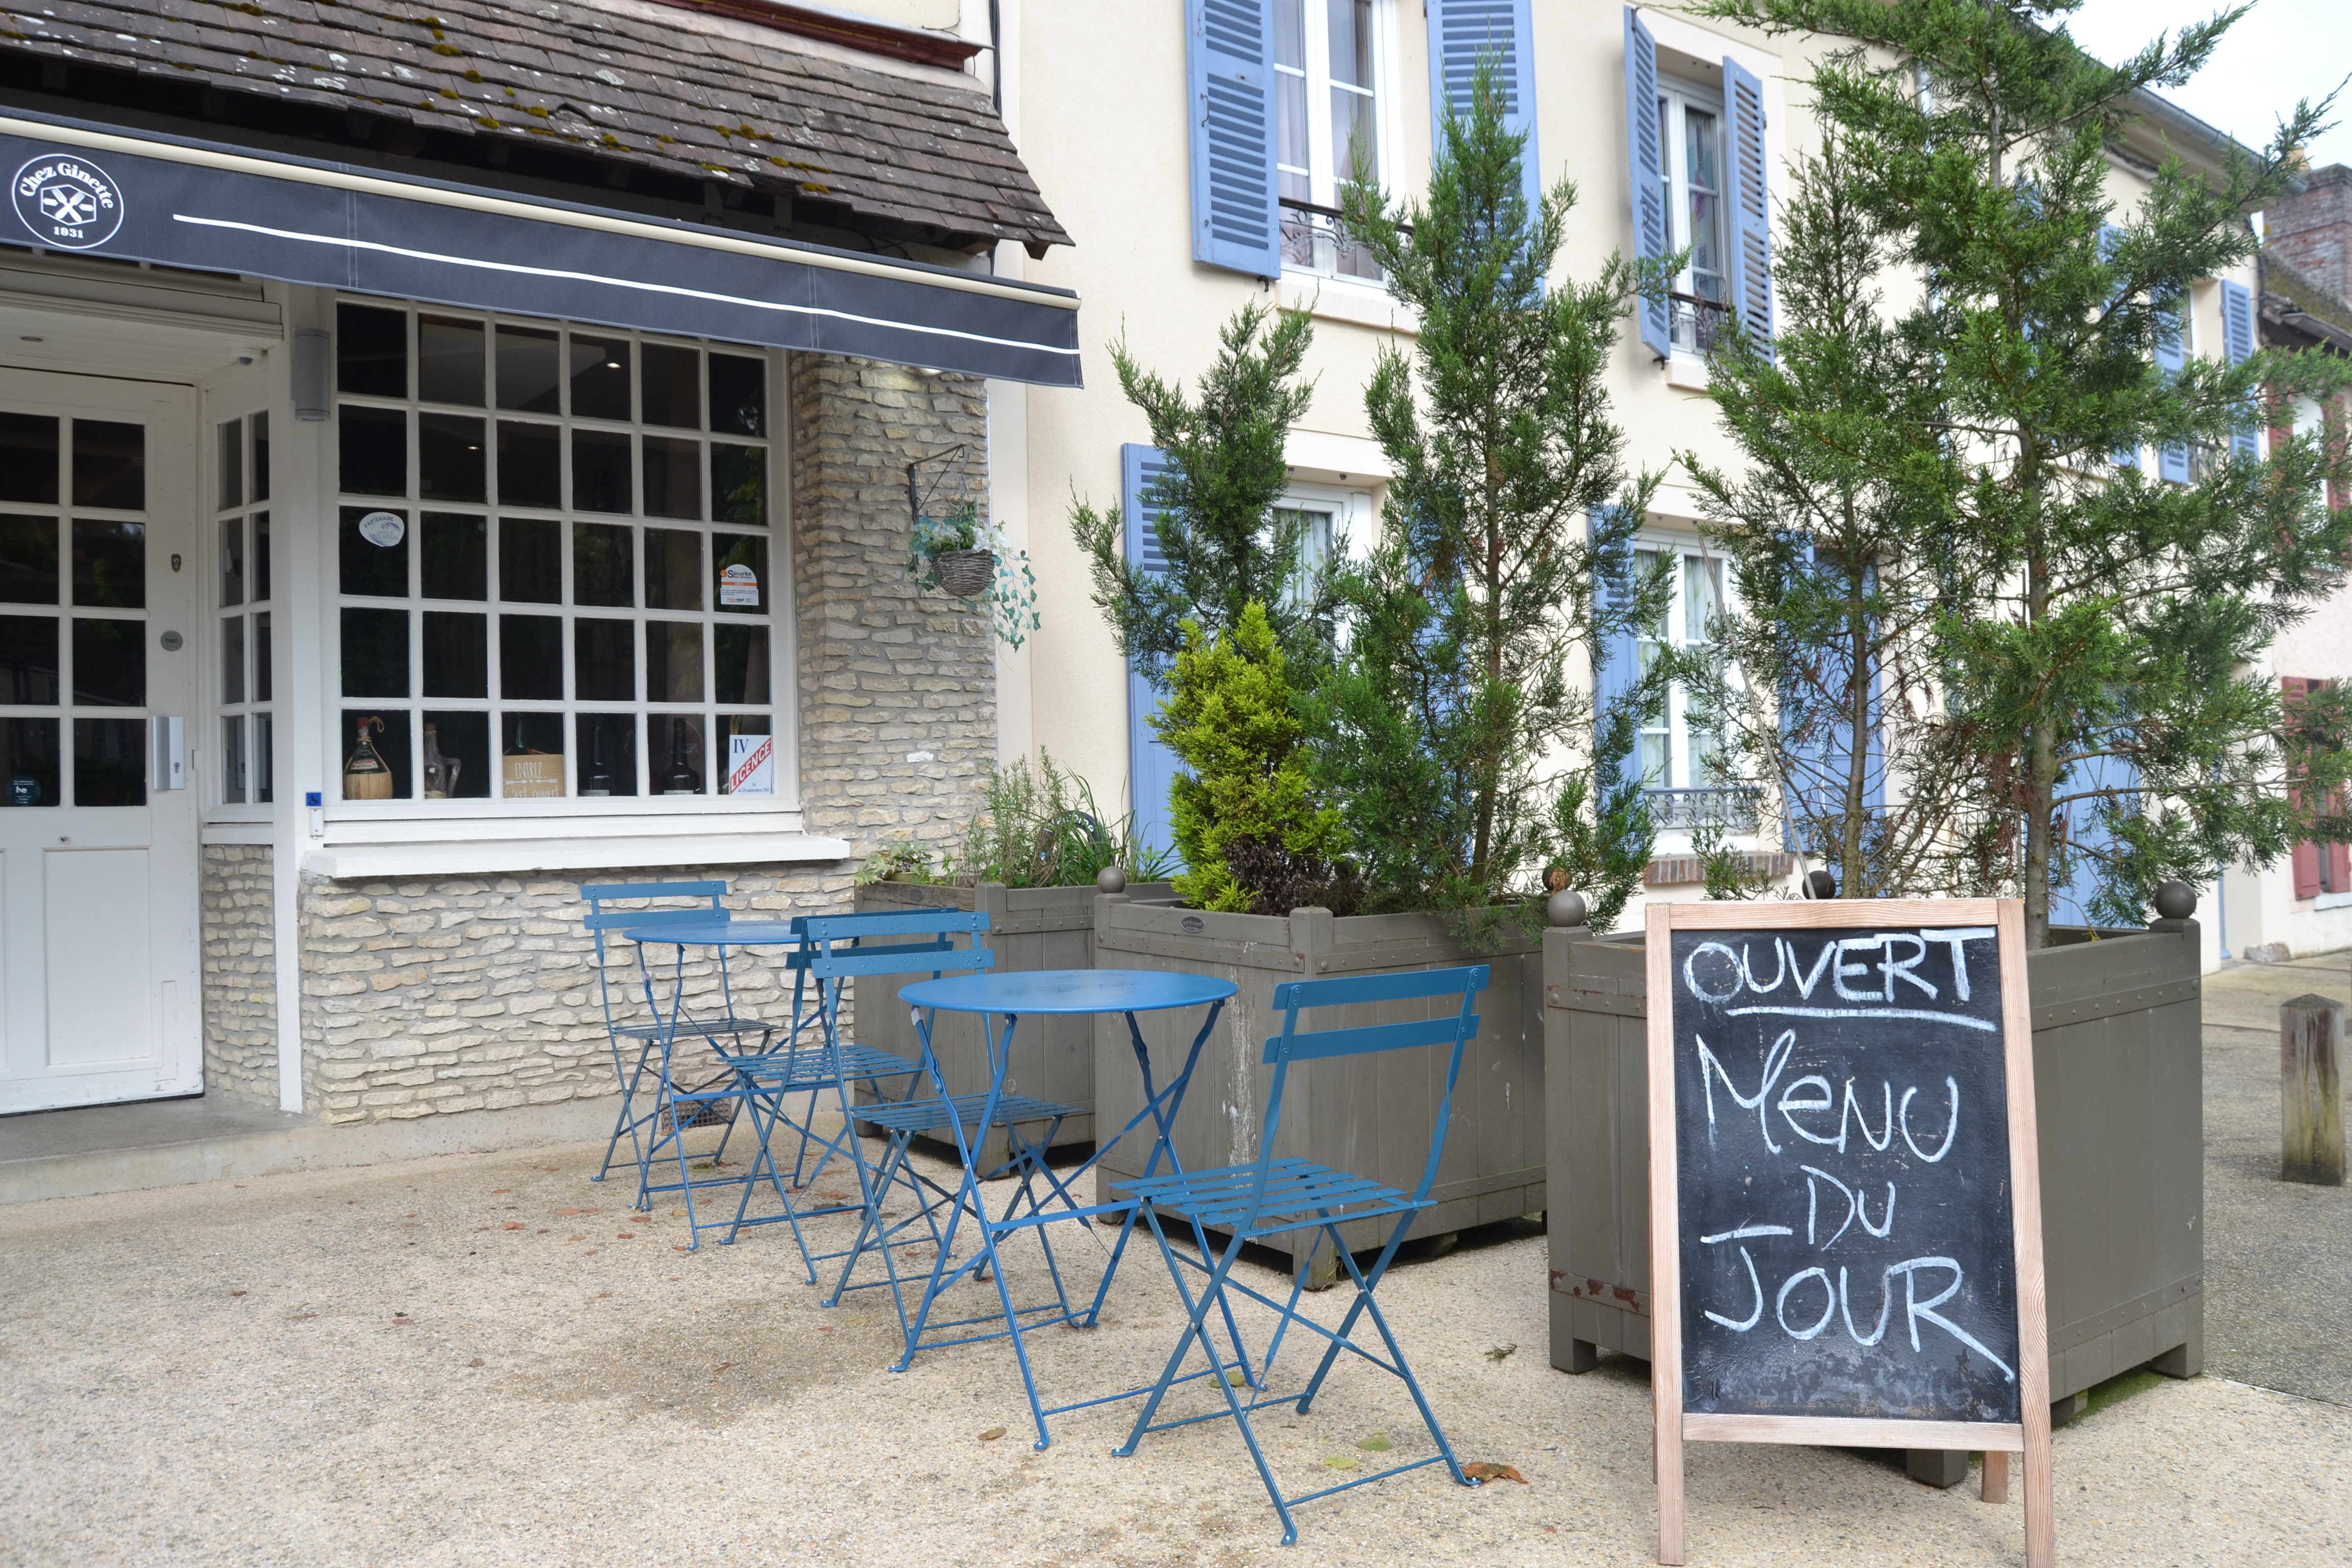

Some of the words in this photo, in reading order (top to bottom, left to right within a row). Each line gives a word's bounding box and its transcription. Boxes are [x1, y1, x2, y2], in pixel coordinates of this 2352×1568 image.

[20, 166, 57, 197] Chez
[57, 162, 114, 209] Ginette
[53, 226, 84, 239] 1931
[363, 516, 394, 528] PARTENAIRE
[727, 570, 752, 578] Sécurité
[733, 739, 749, 753] IV
[731, 740, 770, 790] LICENCE
[1683, 926, 1997, 1004] OUVERT
[1700, 1224, 2015, 1383] JOUR
